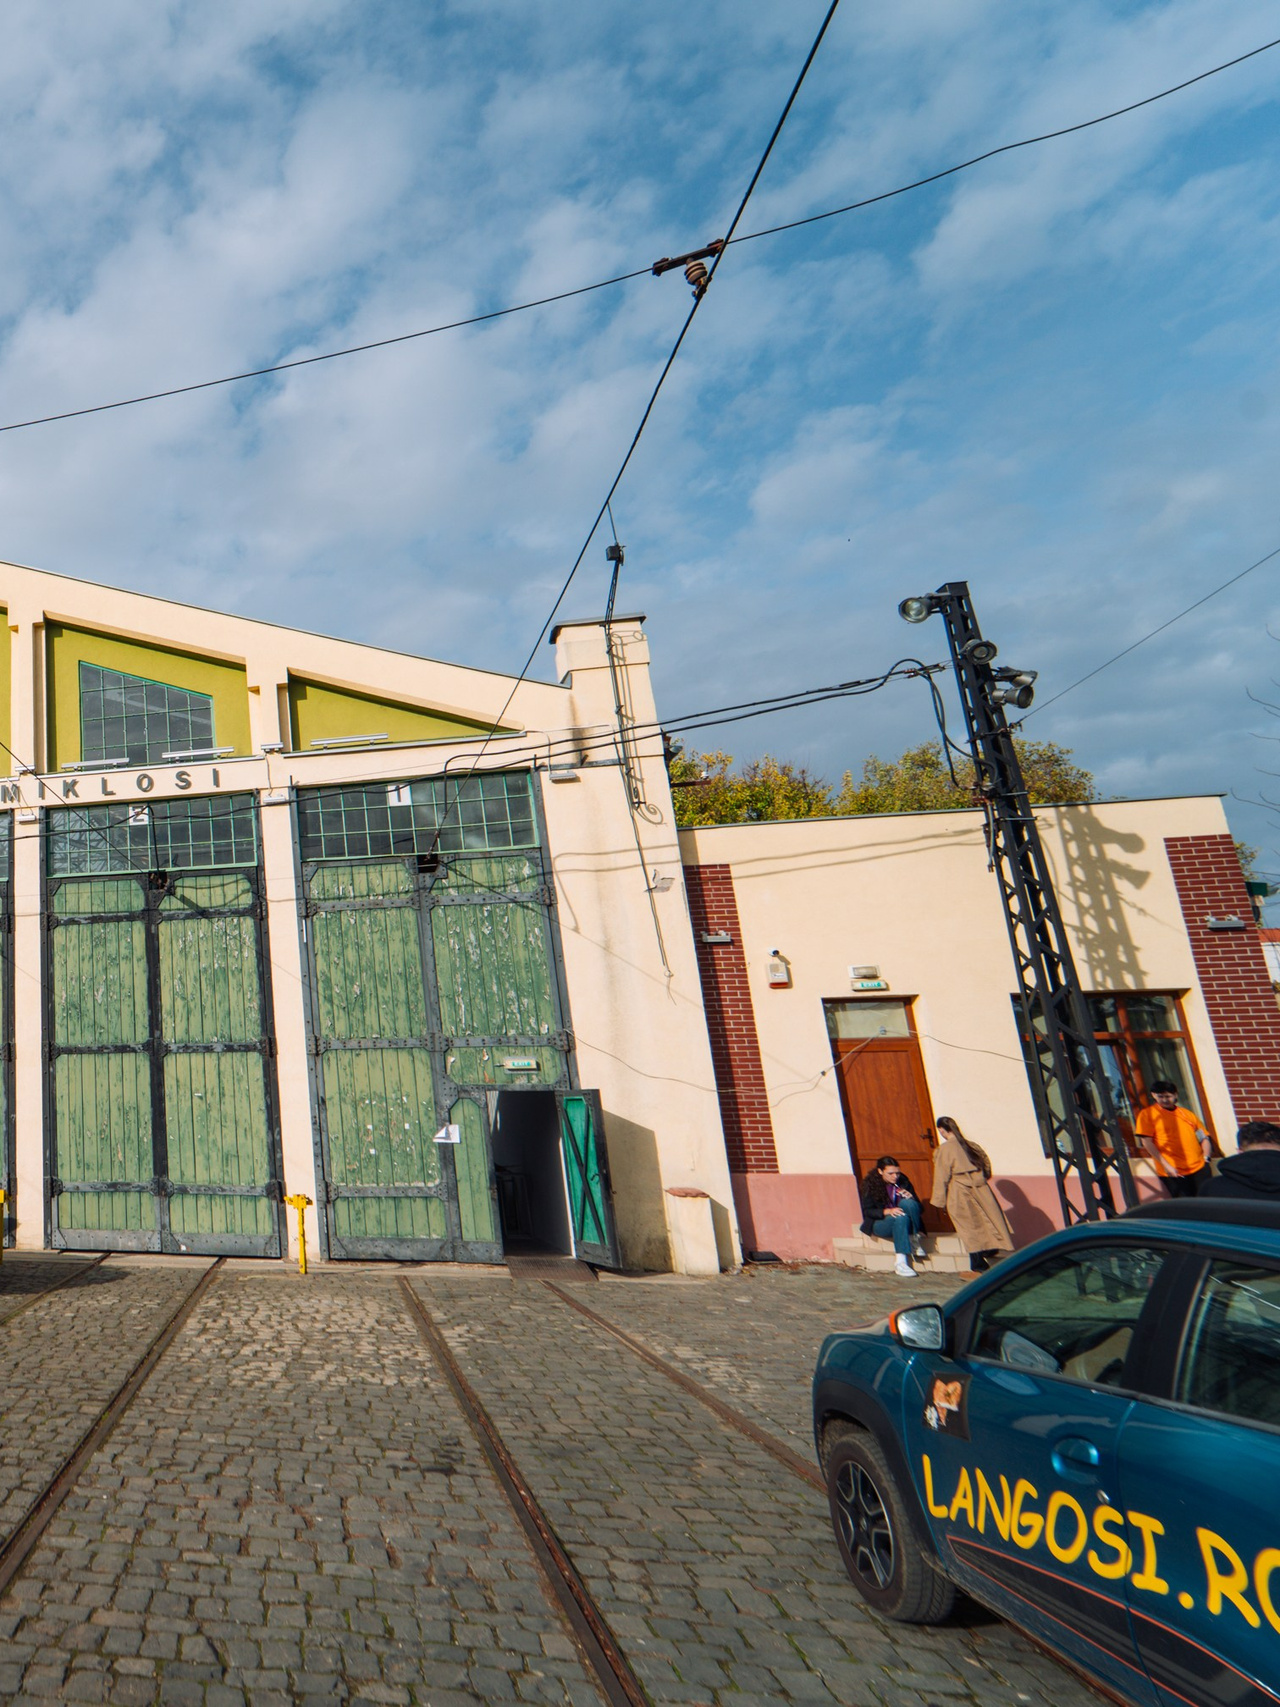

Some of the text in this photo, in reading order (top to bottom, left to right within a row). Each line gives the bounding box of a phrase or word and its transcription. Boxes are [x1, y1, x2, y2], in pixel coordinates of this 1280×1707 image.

[0, 767, 221, 804] MIKLOSI
[394, 785, 402, 803] 1
[131, 805, 145, 823] 2
